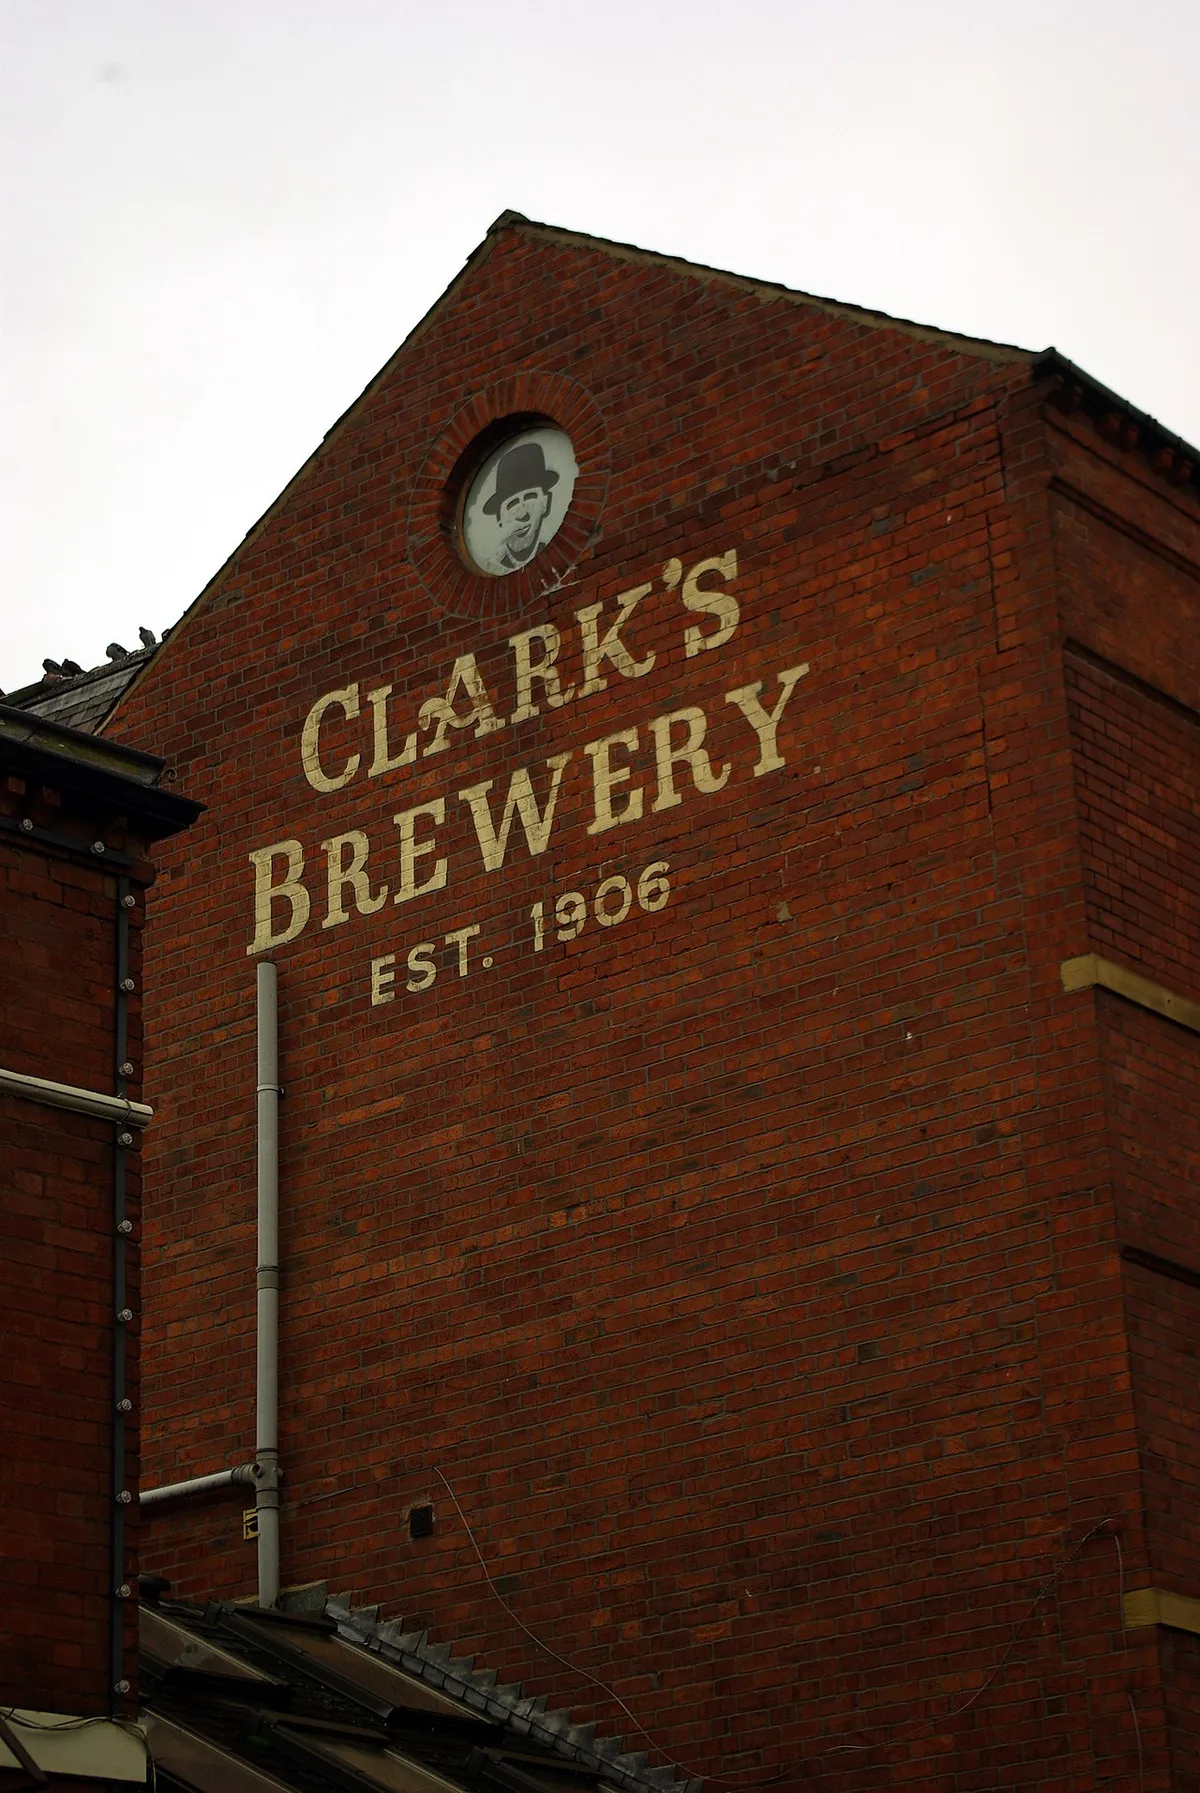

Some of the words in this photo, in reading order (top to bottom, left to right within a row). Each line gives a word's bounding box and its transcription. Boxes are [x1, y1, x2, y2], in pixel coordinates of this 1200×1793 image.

[300, 549, 741, 793] CLARK'S
[246, 663, 810, 956] BREWERY
[371, 924, 494, 1006] EST.
[529, 861, 671, 952] 1906
